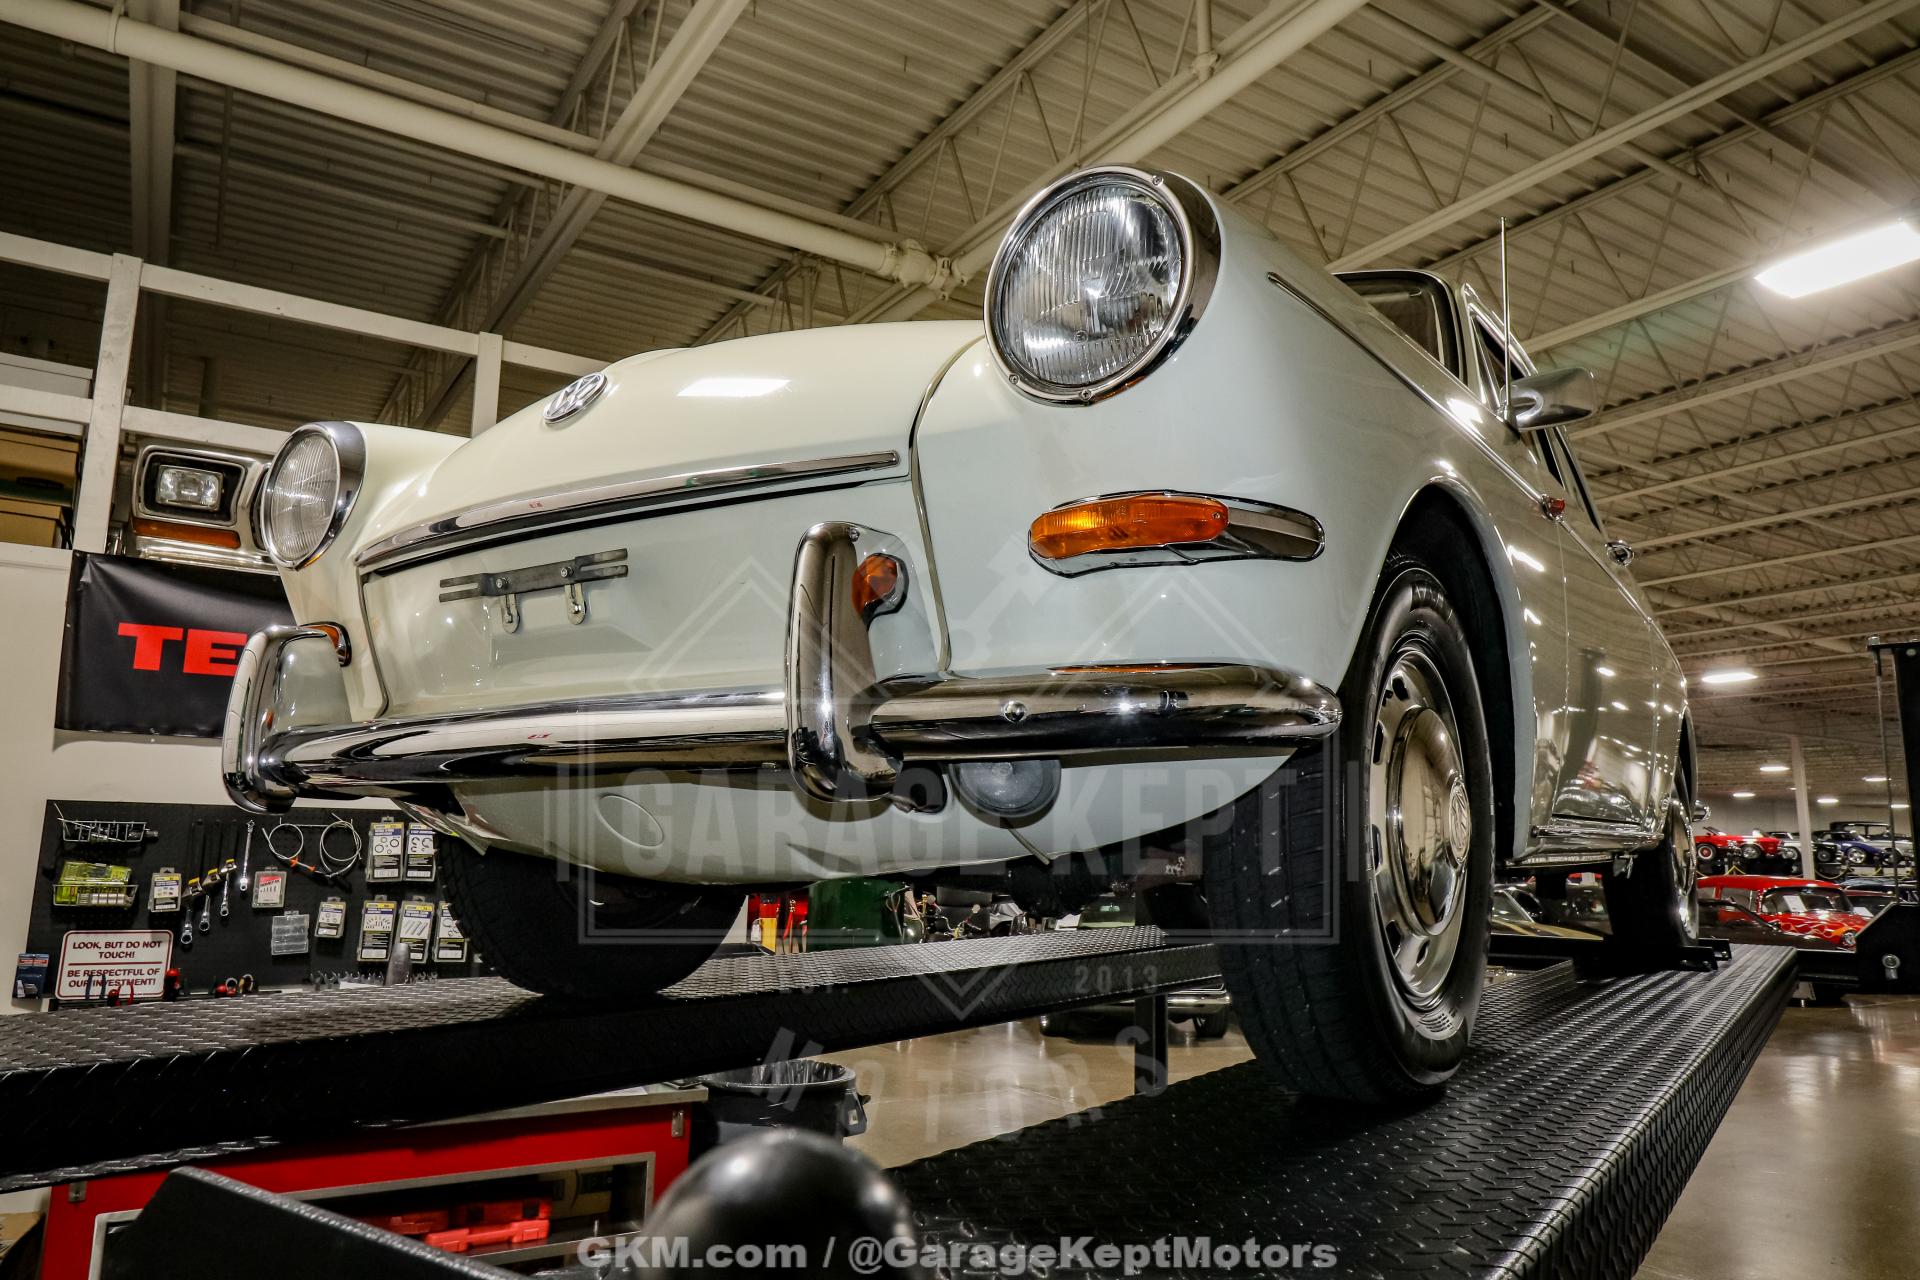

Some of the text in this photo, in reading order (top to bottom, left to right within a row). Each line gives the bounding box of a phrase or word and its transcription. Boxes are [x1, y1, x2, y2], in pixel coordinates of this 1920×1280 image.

[104, 941, 124, 949] BUT
[126, 941, 140, 949] DO
[142, 940, 162, 948] NOT
[98, 951, 135, 959] TOUCH!
[67, 968, 161, 978] BE RESPECTFUL OF
[68, 979, 90, 988] OUR
